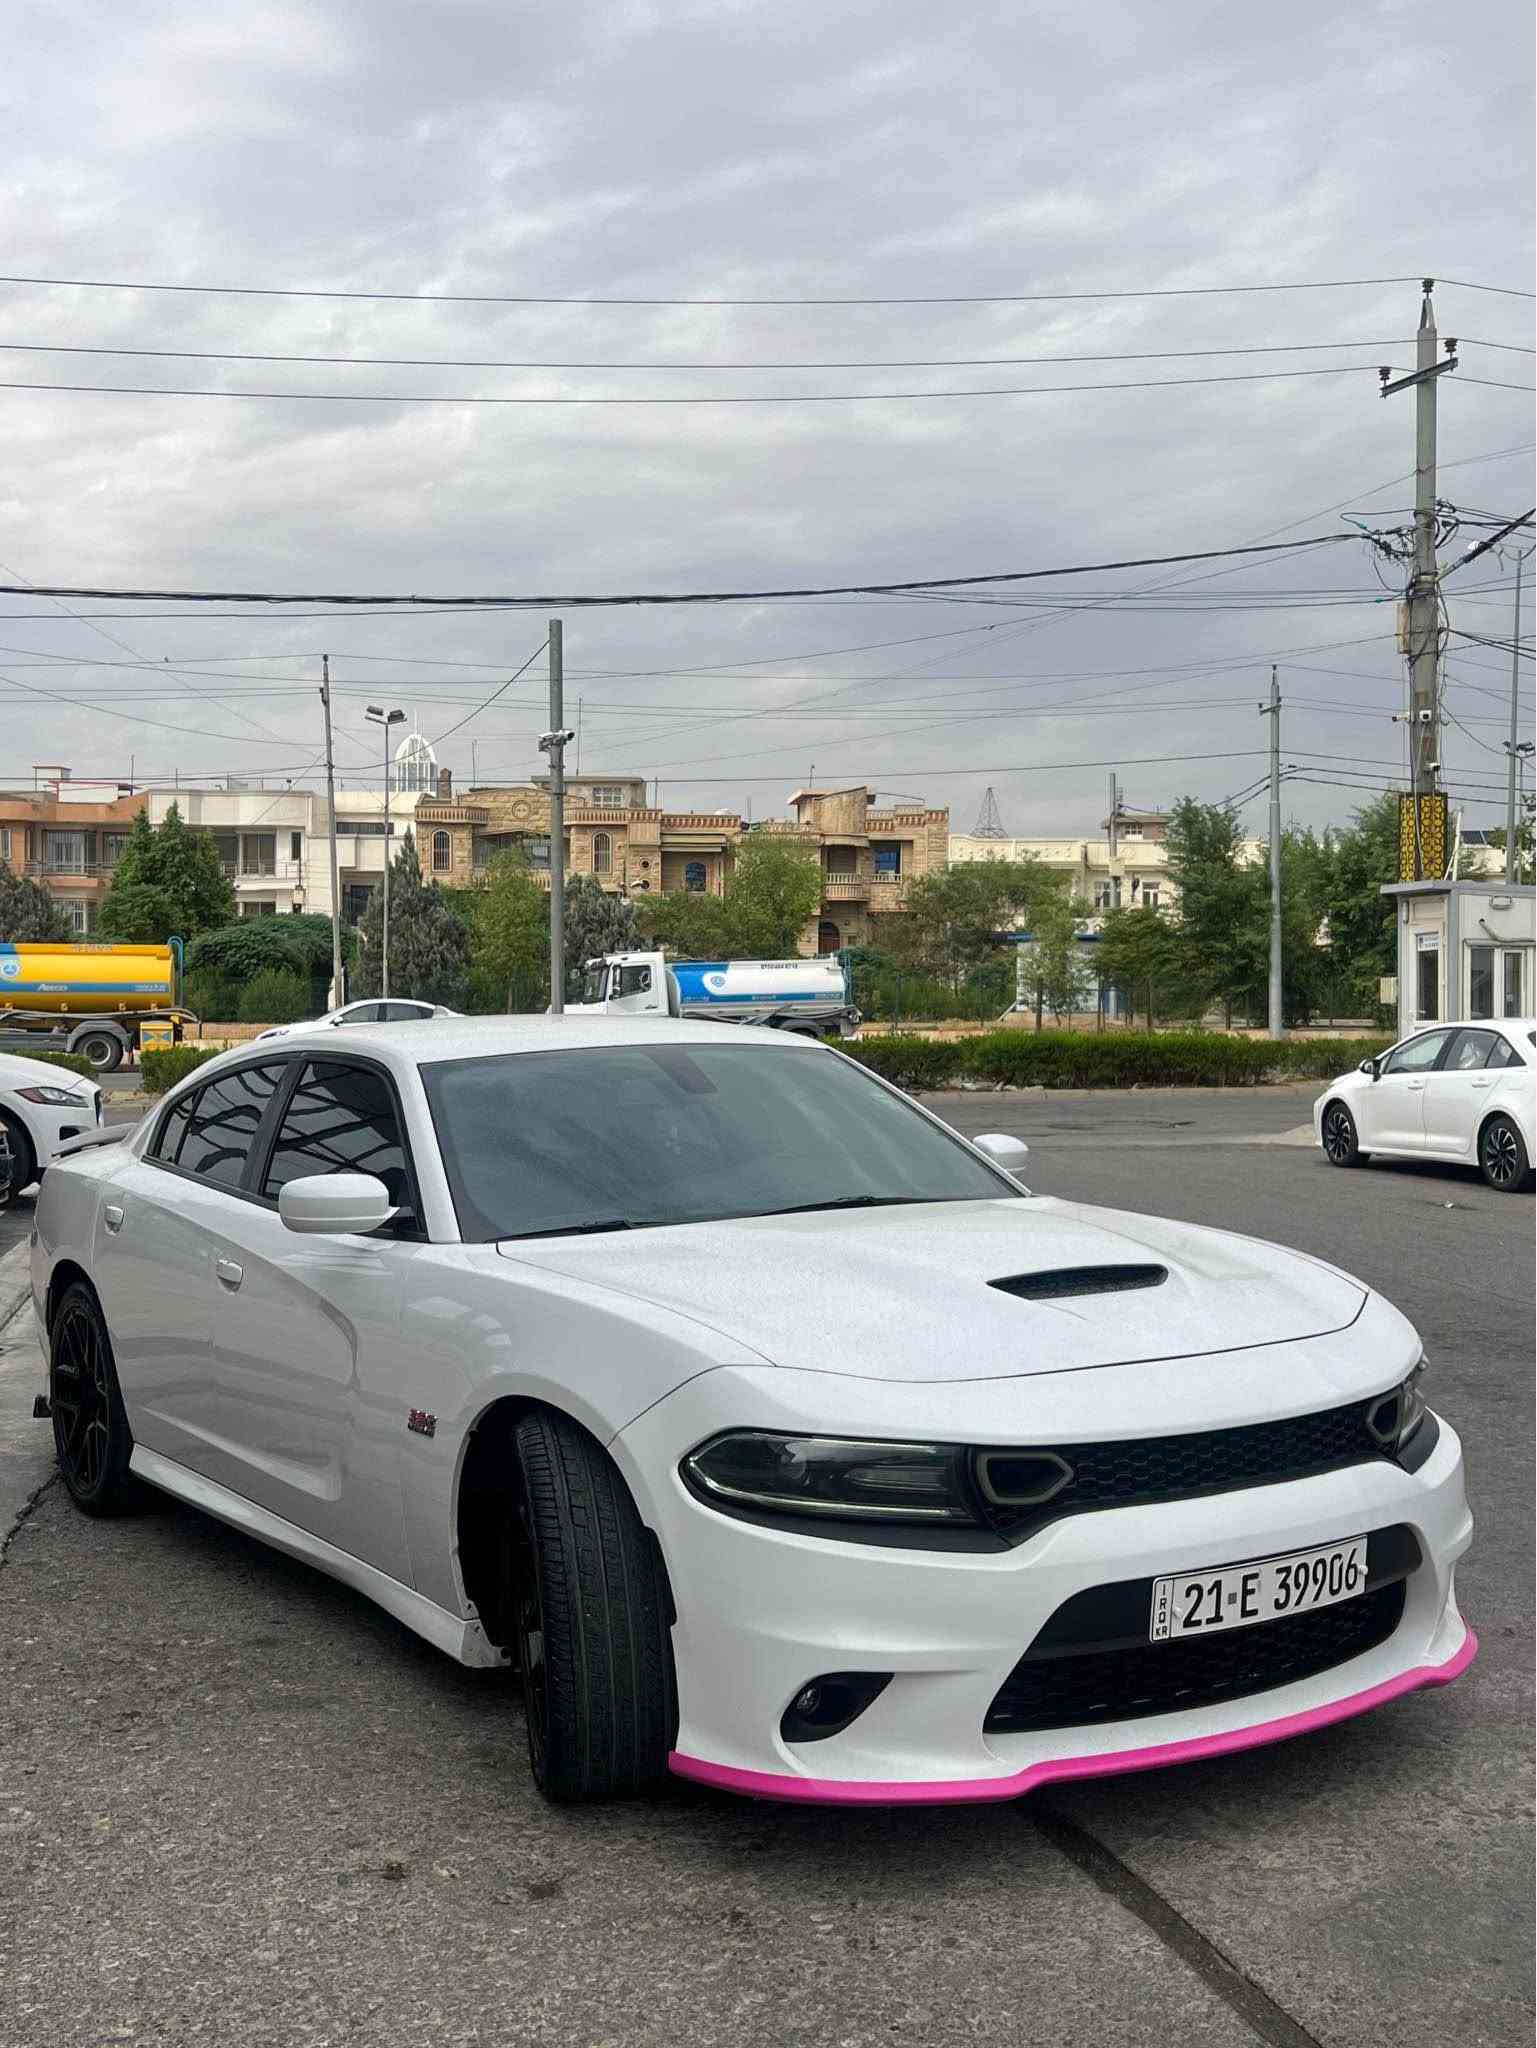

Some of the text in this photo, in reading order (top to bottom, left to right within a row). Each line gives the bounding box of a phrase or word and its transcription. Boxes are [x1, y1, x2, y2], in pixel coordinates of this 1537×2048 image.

[1182, 1547, 1359, 1629] 21 E 39906
